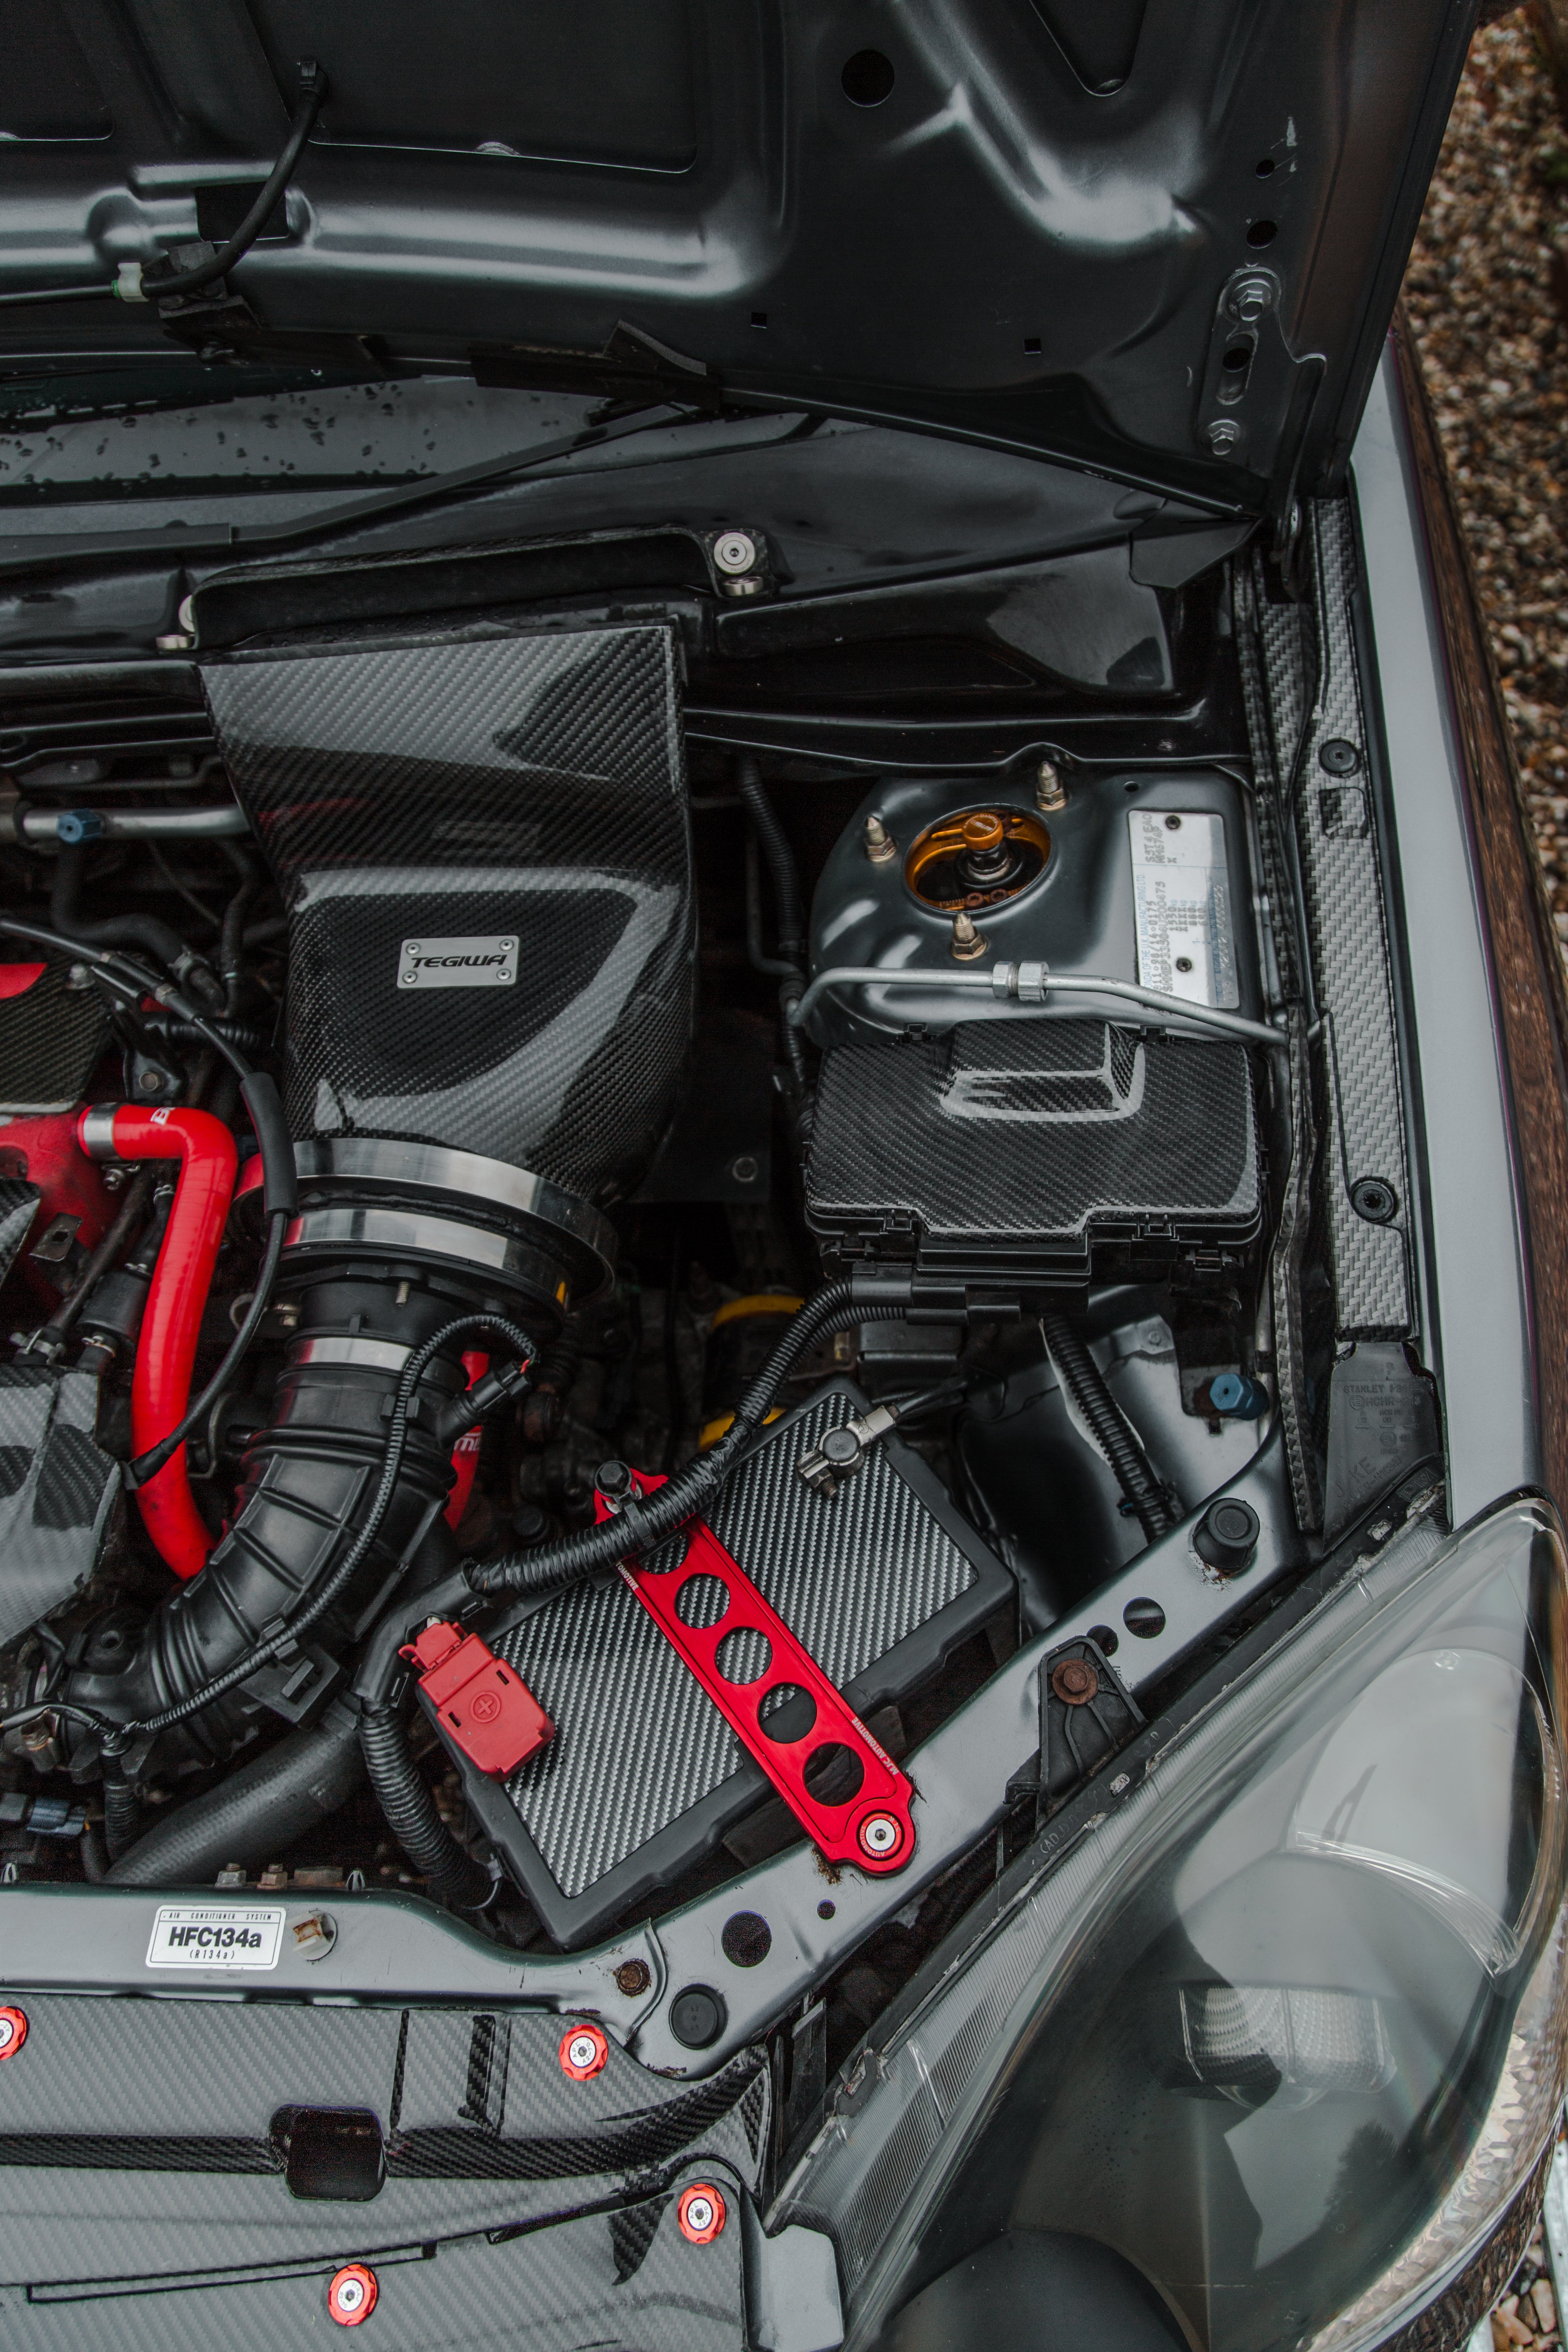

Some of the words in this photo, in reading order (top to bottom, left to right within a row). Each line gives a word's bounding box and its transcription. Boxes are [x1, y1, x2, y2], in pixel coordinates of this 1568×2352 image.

[411, 954, 508, 968] TEGIWA
[1141, 949, 1150, 960] THE
[615, 1561, 639, 1591] TOMOTIVE
[851, 1717, 886, 1759] AUTOMOTIVE
[883, 1757, 899, 1775] MJC
[889, 1816, 901, 1832] MJC
[860, 1825, 885, 1857] AUTOMOTIVE
[168, 1927, 262, 1947] HFC134a
[189, 1950, 235, 1959] (R134a)
[572, 2041, 580, 2058] APL
[583, 2042, 592, 2063] A2-70
[690, 2203, 698, 2219] APL
[698, 2205, 710, 2227] A2-70
